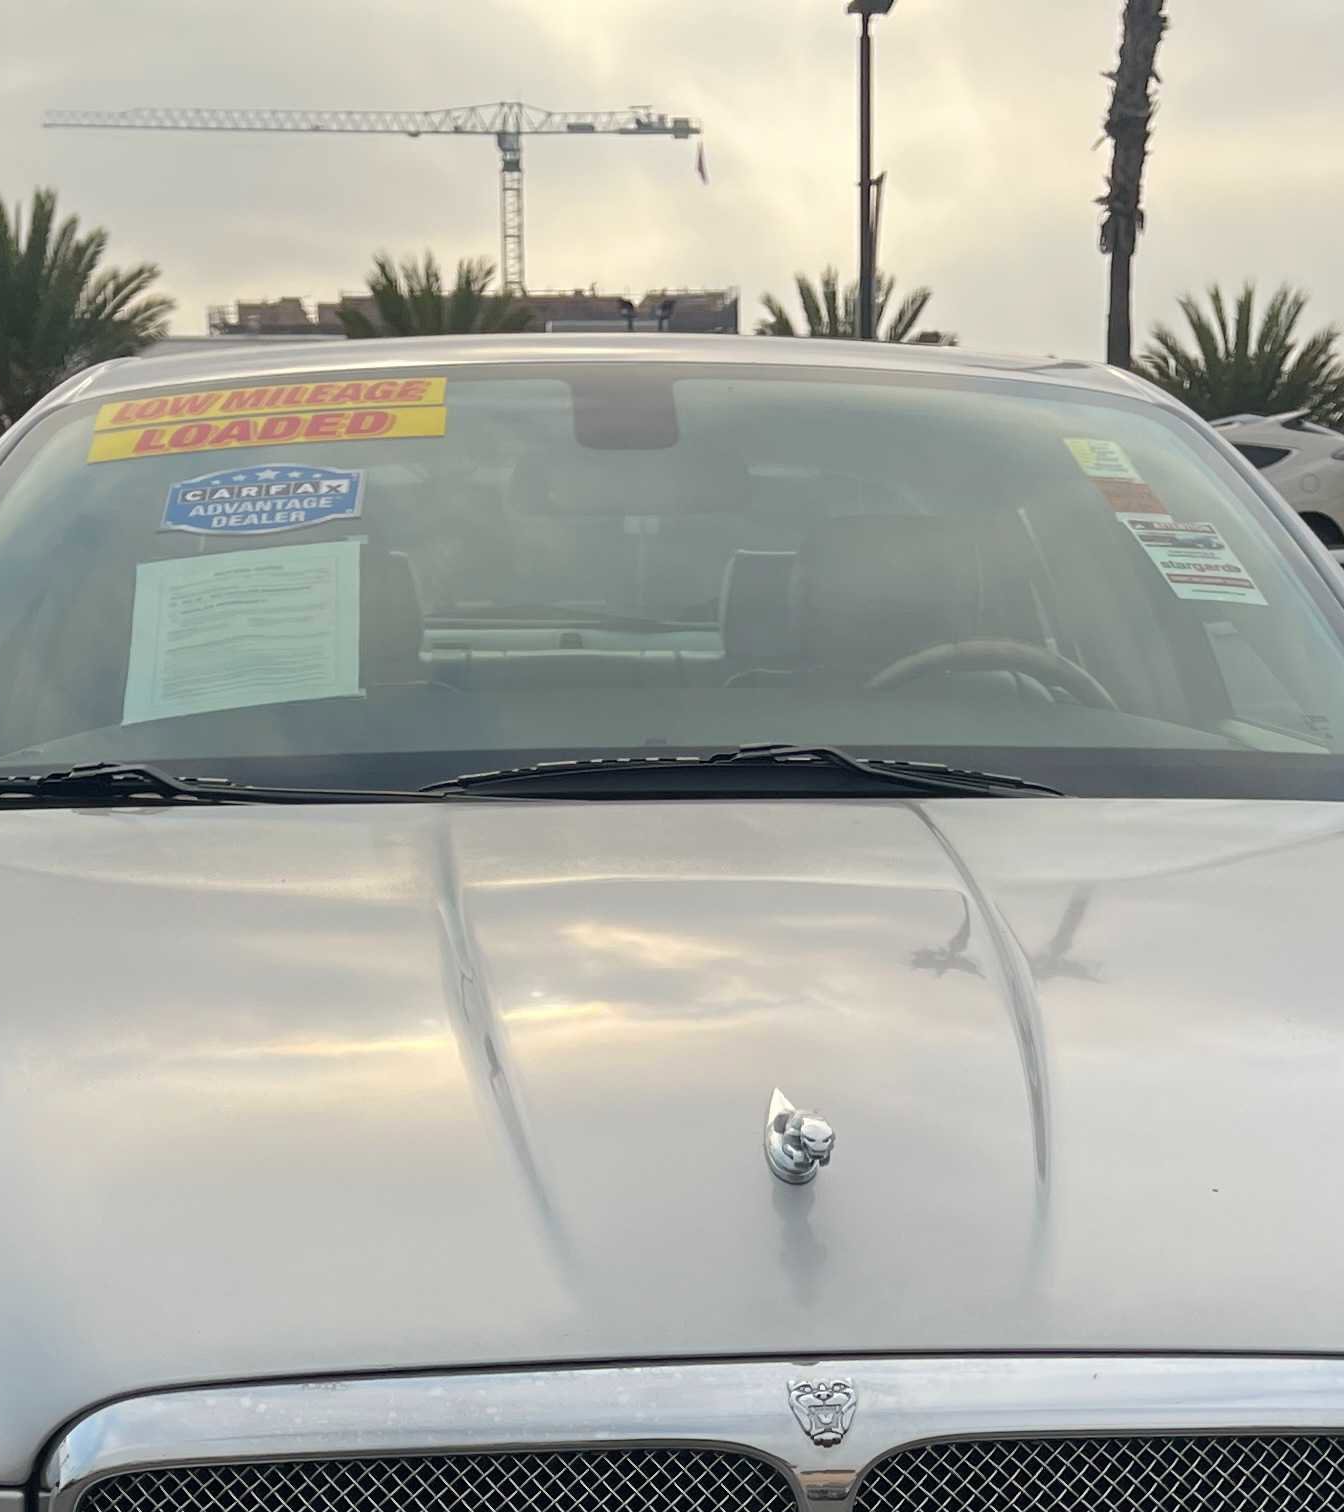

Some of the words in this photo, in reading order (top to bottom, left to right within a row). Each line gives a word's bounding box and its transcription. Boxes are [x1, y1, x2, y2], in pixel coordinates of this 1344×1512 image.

[111, 393, 217, 424] LOW
[218, 380, 432, 413] MILEAGE
[133, 411, 397, 453] LOADED
[182, 480, 347, 503] CARFAX
[188, 496, 334, 518] ADVANTAGE
[210, 511, 306, 529] DEALER
